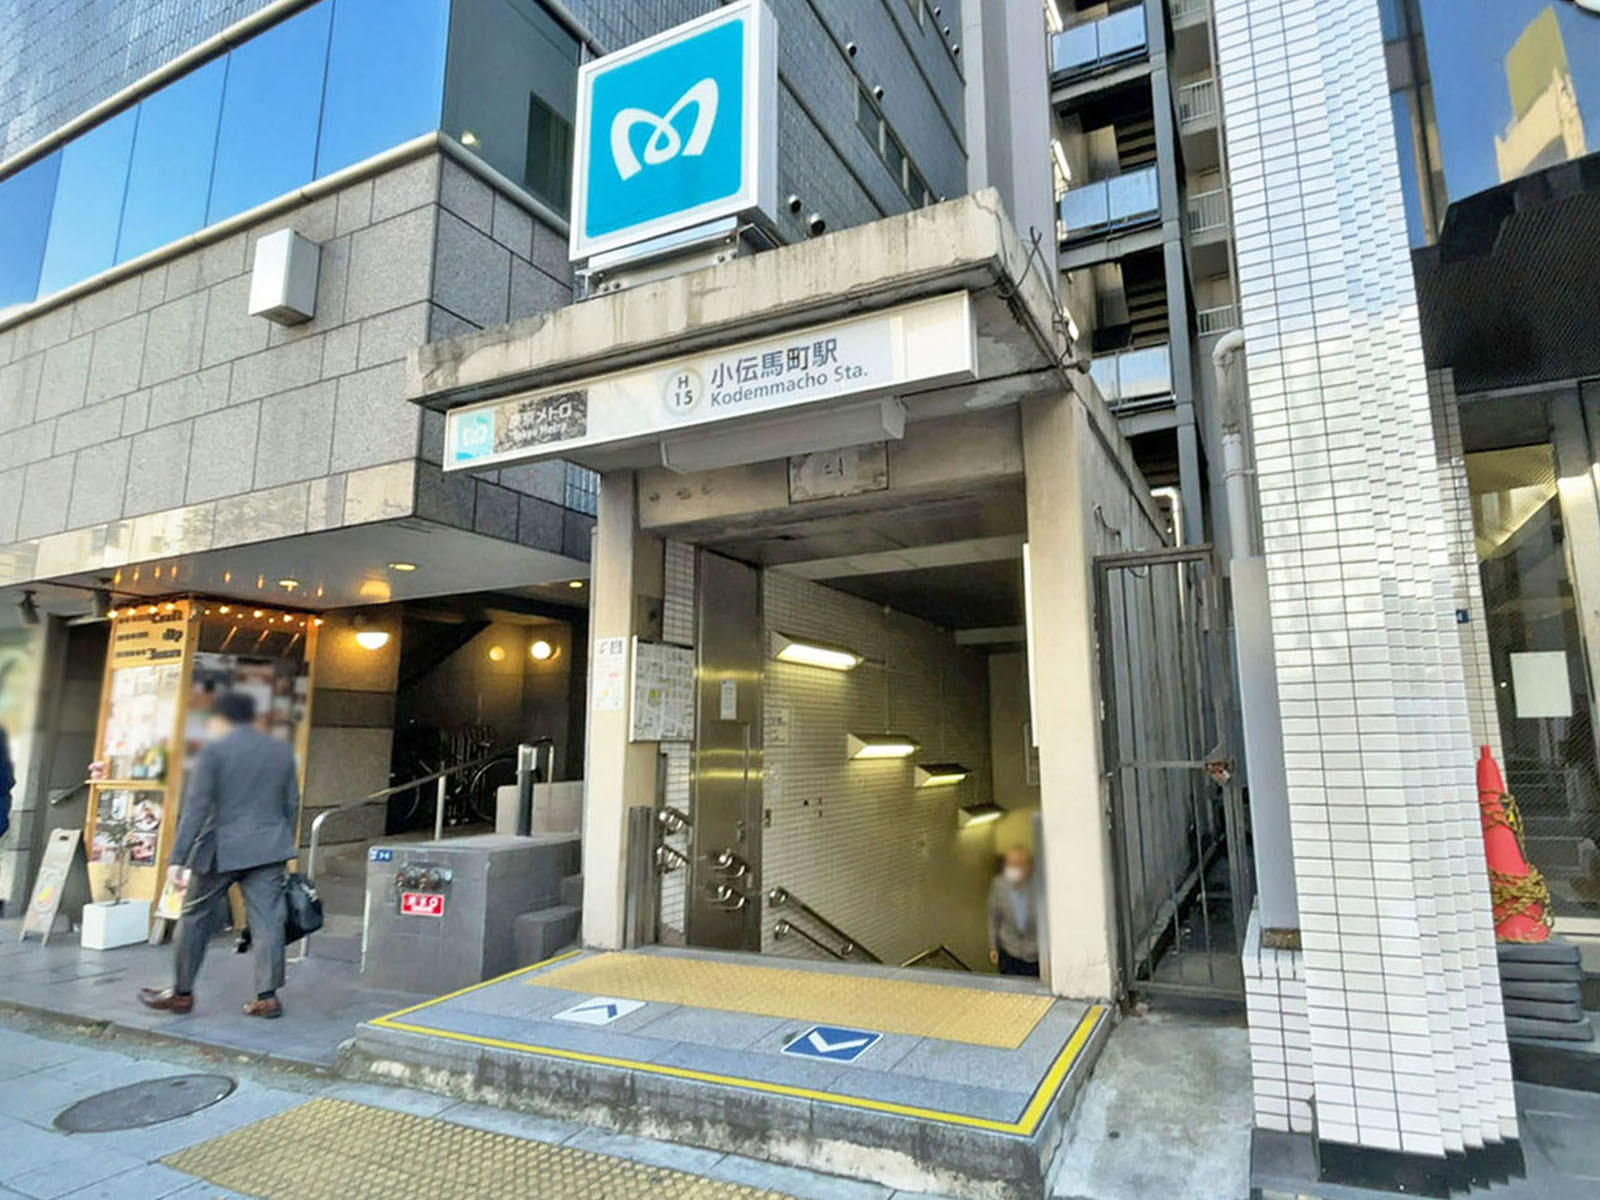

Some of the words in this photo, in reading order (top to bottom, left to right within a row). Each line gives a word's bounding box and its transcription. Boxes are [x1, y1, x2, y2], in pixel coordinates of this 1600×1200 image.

[710, 338, 838, 389] 小伝馬町駅
[677, 375, 689, 389] H
[710, 372, 828, 407] Kodemmacho
[834, 364, 869, 382] Sta.
[674, 390, 693, 407] 15
